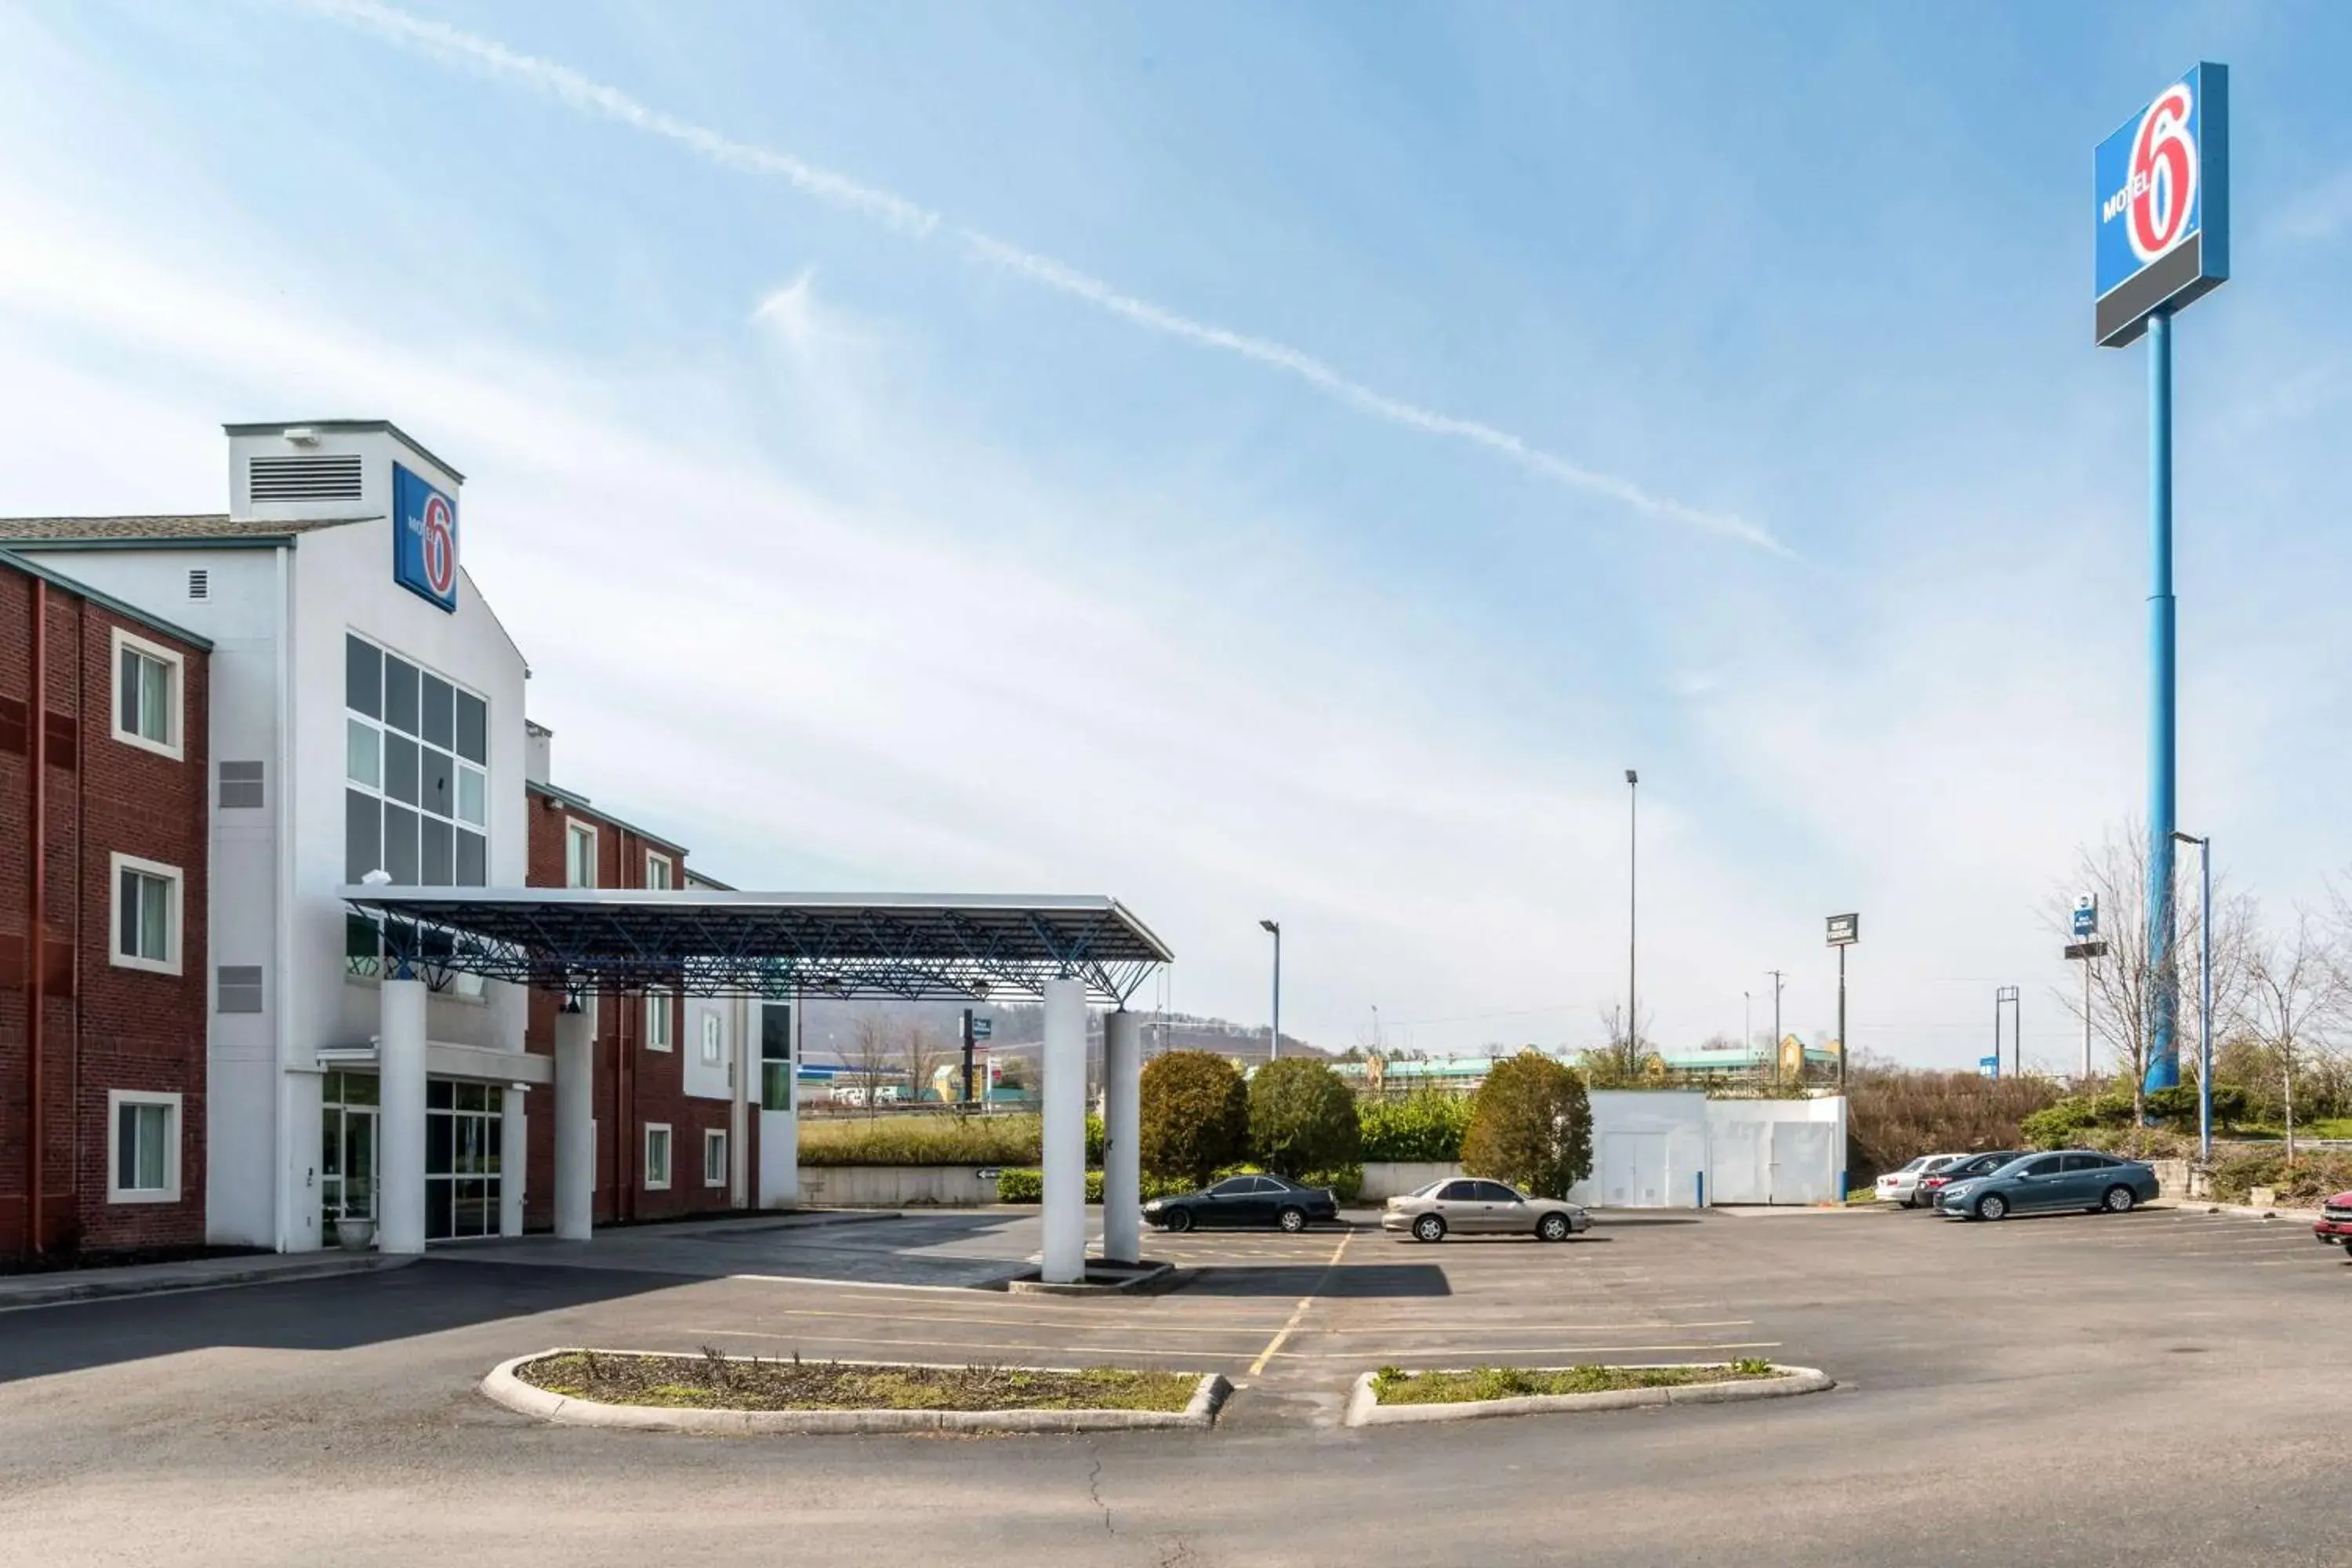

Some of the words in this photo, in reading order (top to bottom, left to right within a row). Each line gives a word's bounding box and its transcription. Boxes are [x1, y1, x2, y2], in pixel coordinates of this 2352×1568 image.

[2103, 169, 2151, 224] MOTEL
[2129, 85, 2195, 263] 6
[423, 493, 454, 596] 6
